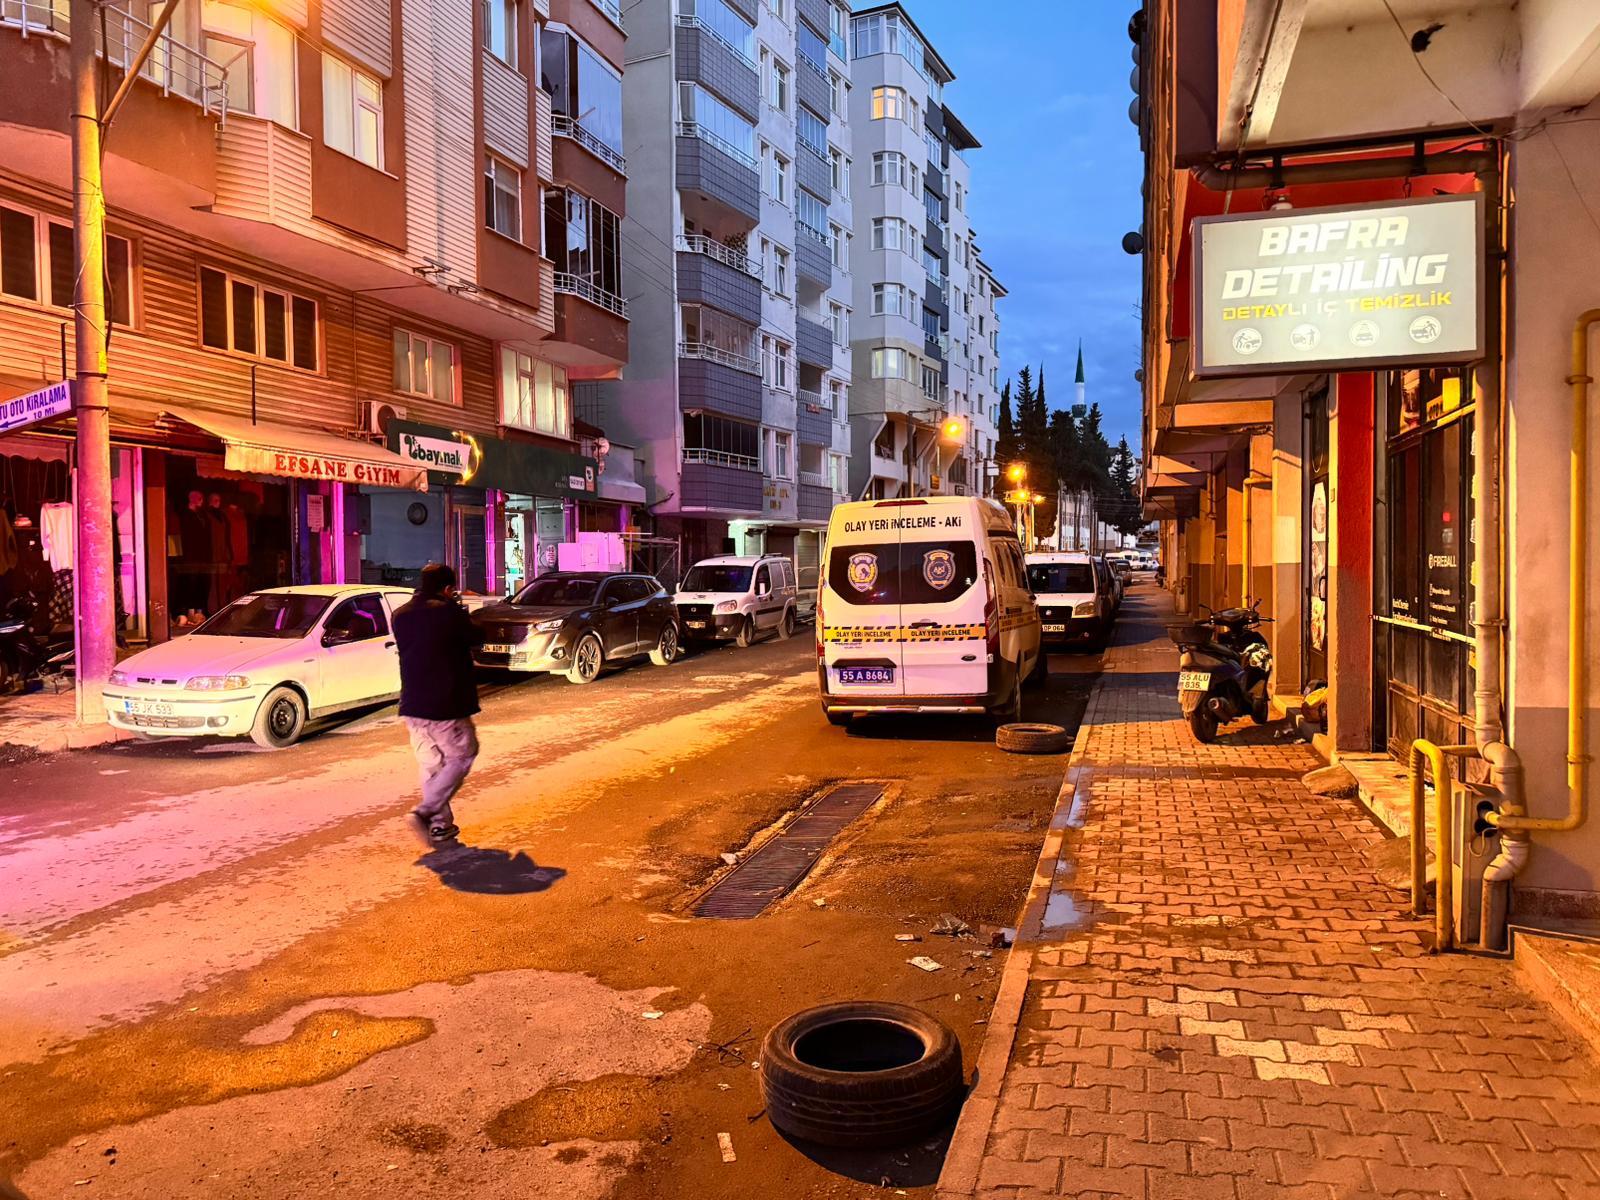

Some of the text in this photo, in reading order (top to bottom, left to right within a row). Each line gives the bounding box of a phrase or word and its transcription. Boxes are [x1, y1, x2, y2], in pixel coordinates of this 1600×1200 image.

[1258, 215, 1409, 257] BAFRA
[1222, 303, 1306, 321] DETAYLI
[10, 399, 25, 417] OTO
[274, 453, 347, 478] EFSANE
[844, 520, 867, 533] OLAY
[842, 671, 889, 680] 55 A 8684
[1181, 673, 1191, 681] 55
